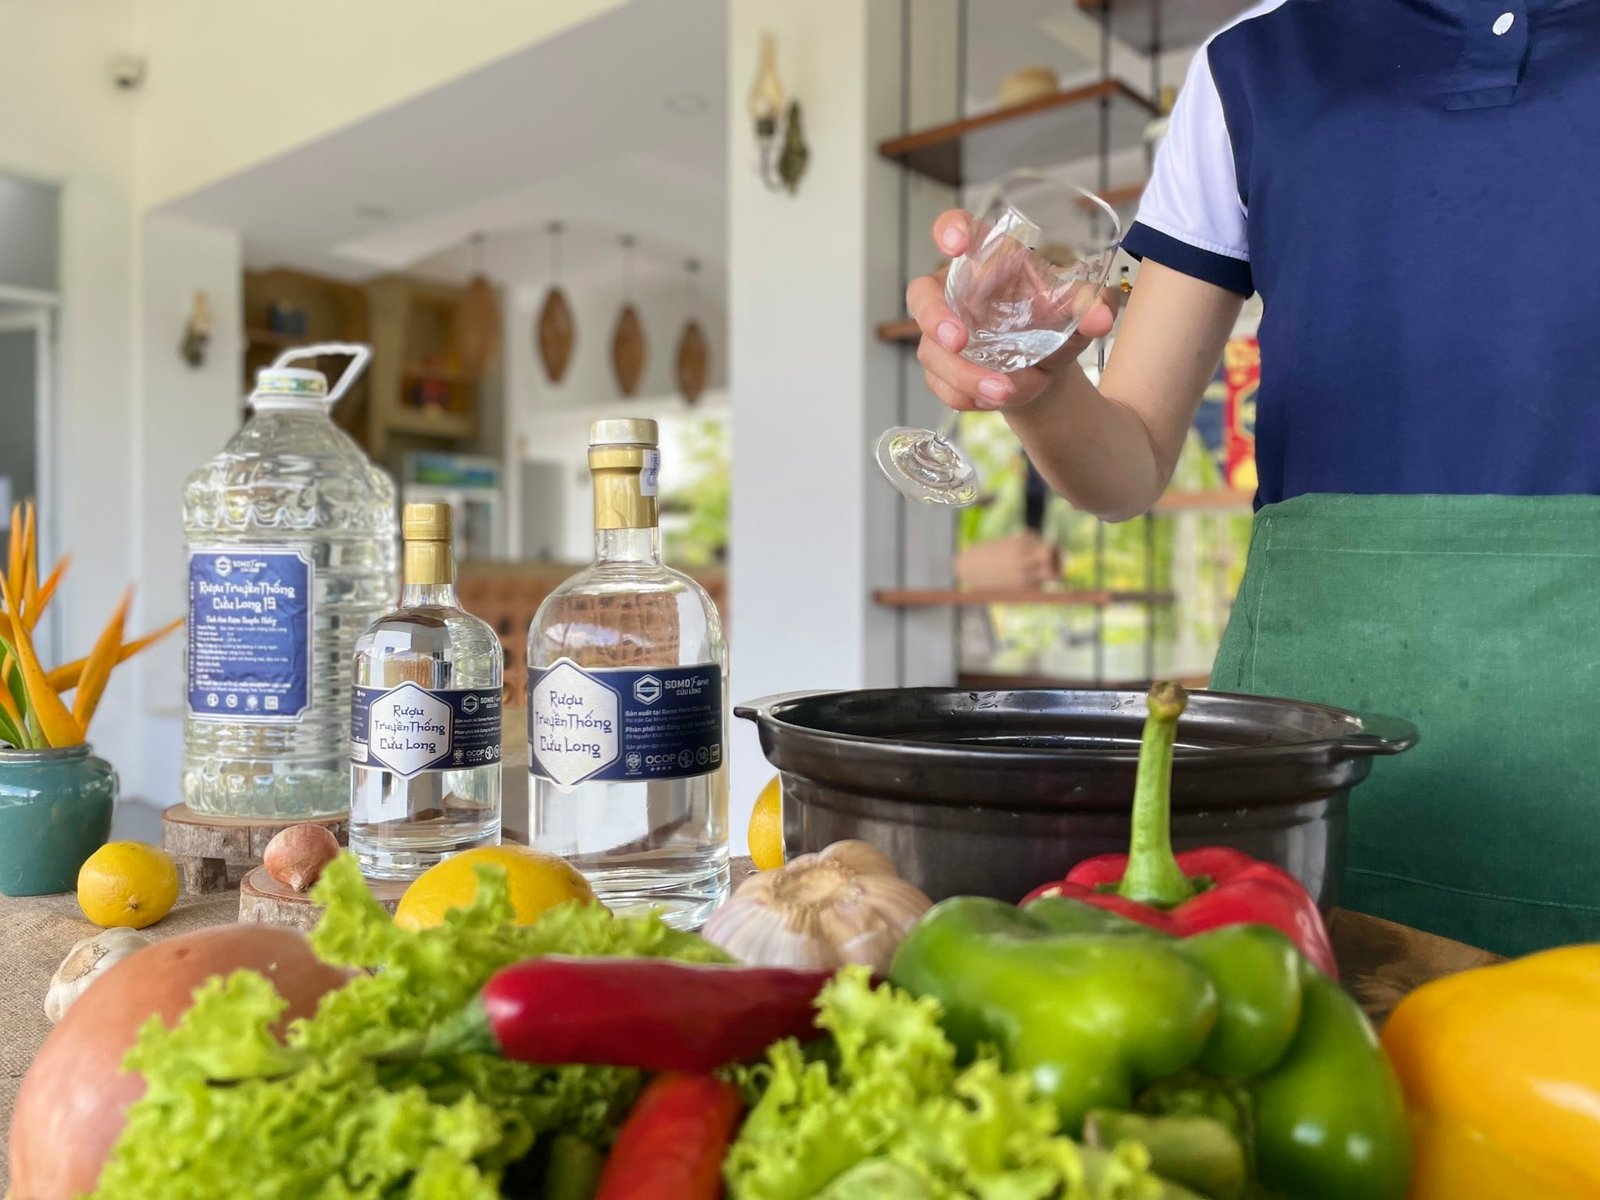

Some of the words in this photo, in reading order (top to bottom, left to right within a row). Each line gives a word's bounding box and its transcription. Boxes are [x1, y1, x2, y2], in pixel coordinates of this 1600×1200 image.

[200, 581, 224, 595] Rượu
[225, 580, 259, 598] Truyền
[259, 579, 295, 598] Thống
[235, 597, 261, 613] Long
[665, 679, 690, 689] SOMO
[550, 691, 583, 709] Rượu
[393, 705, 424, 719] Rượu
[374, 719, 409, 735] Truyền
[409, 718, 446, 735] Thống
[535, 709, 567, 732] Truyền
[567, 709, 612, 733] Thống
[380, 737, 403, 750] Cửu
[406, 738, 436, 753] Long
[466, 749, 485, 757] OCOP
[540, 734, 561, 751] Cửu
[565, 737, 600, 758] Long
[646, 754, 676, 764] OCOP
